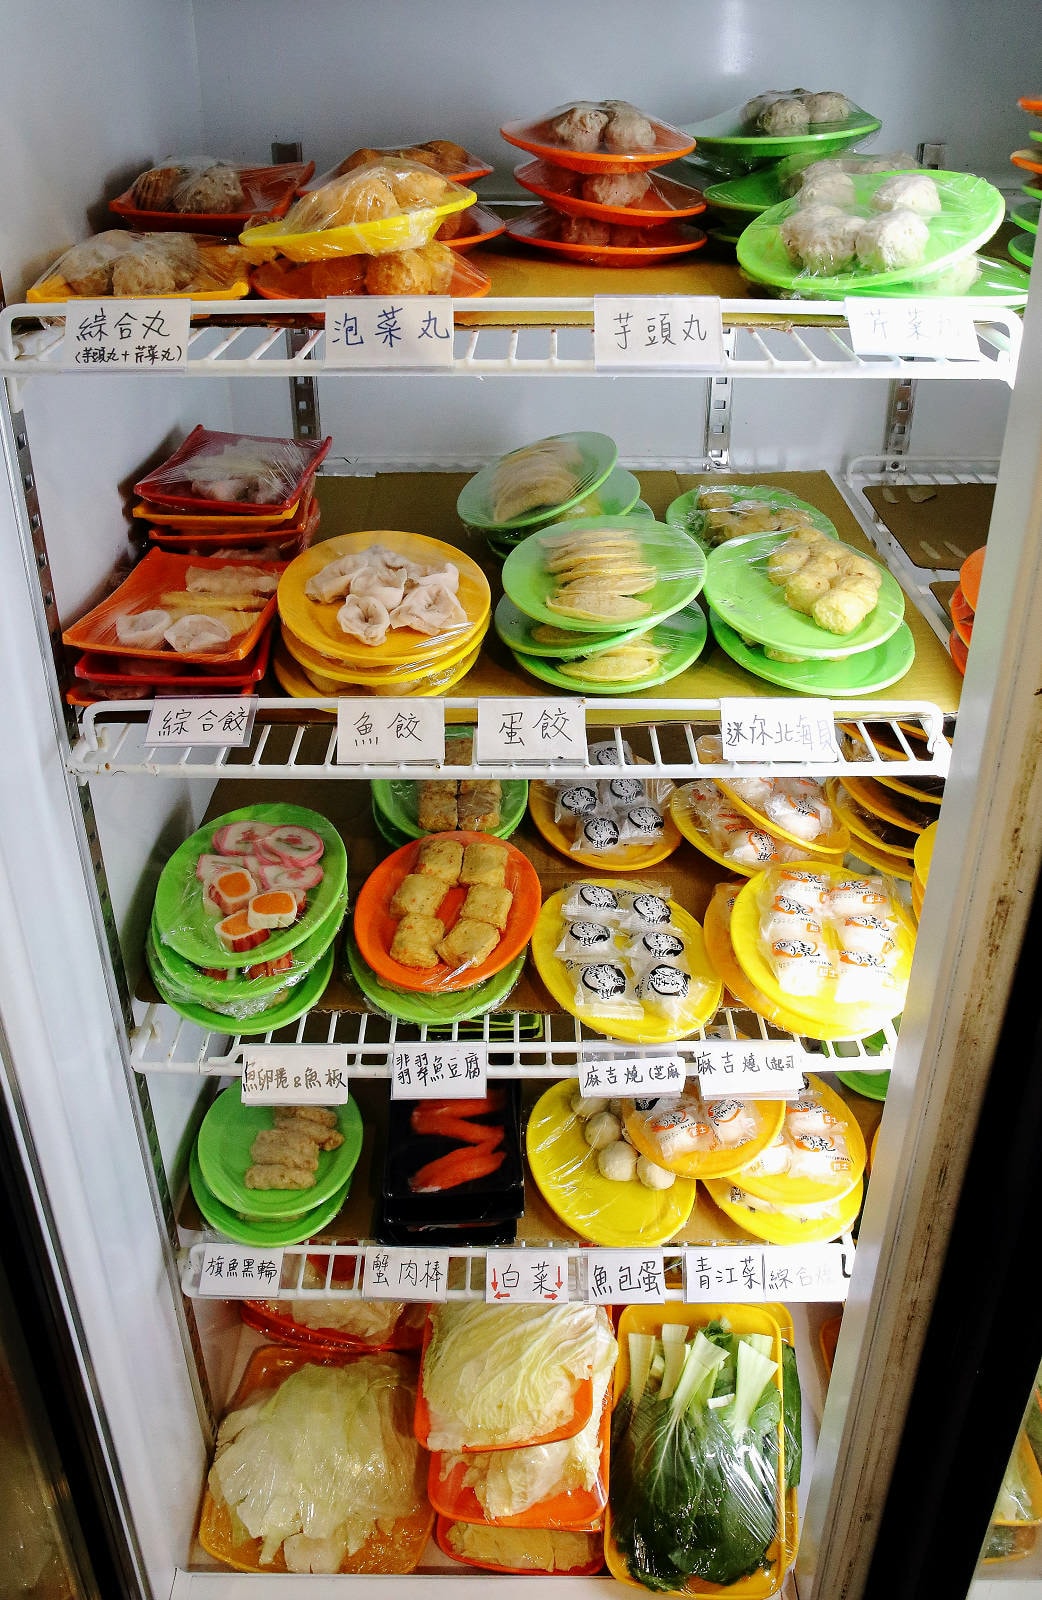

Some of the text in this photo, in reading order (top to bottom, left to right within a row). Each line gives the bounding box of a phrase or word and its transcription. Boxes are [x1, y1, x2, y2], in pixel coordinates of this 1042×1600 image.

[76, 307, 170, 342] 綜合丸
[332, 306, 451, 348] 泡菜丸
[613, 312, 708, 350] 芋頭丸
[157, 709, 248, 738] 綜合餃
[352, 711, 423, 746] 魚餃
[498, 708, 574, 747] 蛋餃
[725, 713, 837, 754] 迷你北海貝
[395, 1053, 481, 1087] 翡翠魚豆腐
[373, 1254, 444, 1292] 蟹肉棒
[501, 1261, 556, 1294] 白菜
[592, 1260, 661, 1296] 魚包蛋
[695, 1255, 762, 1291] 青江菜
